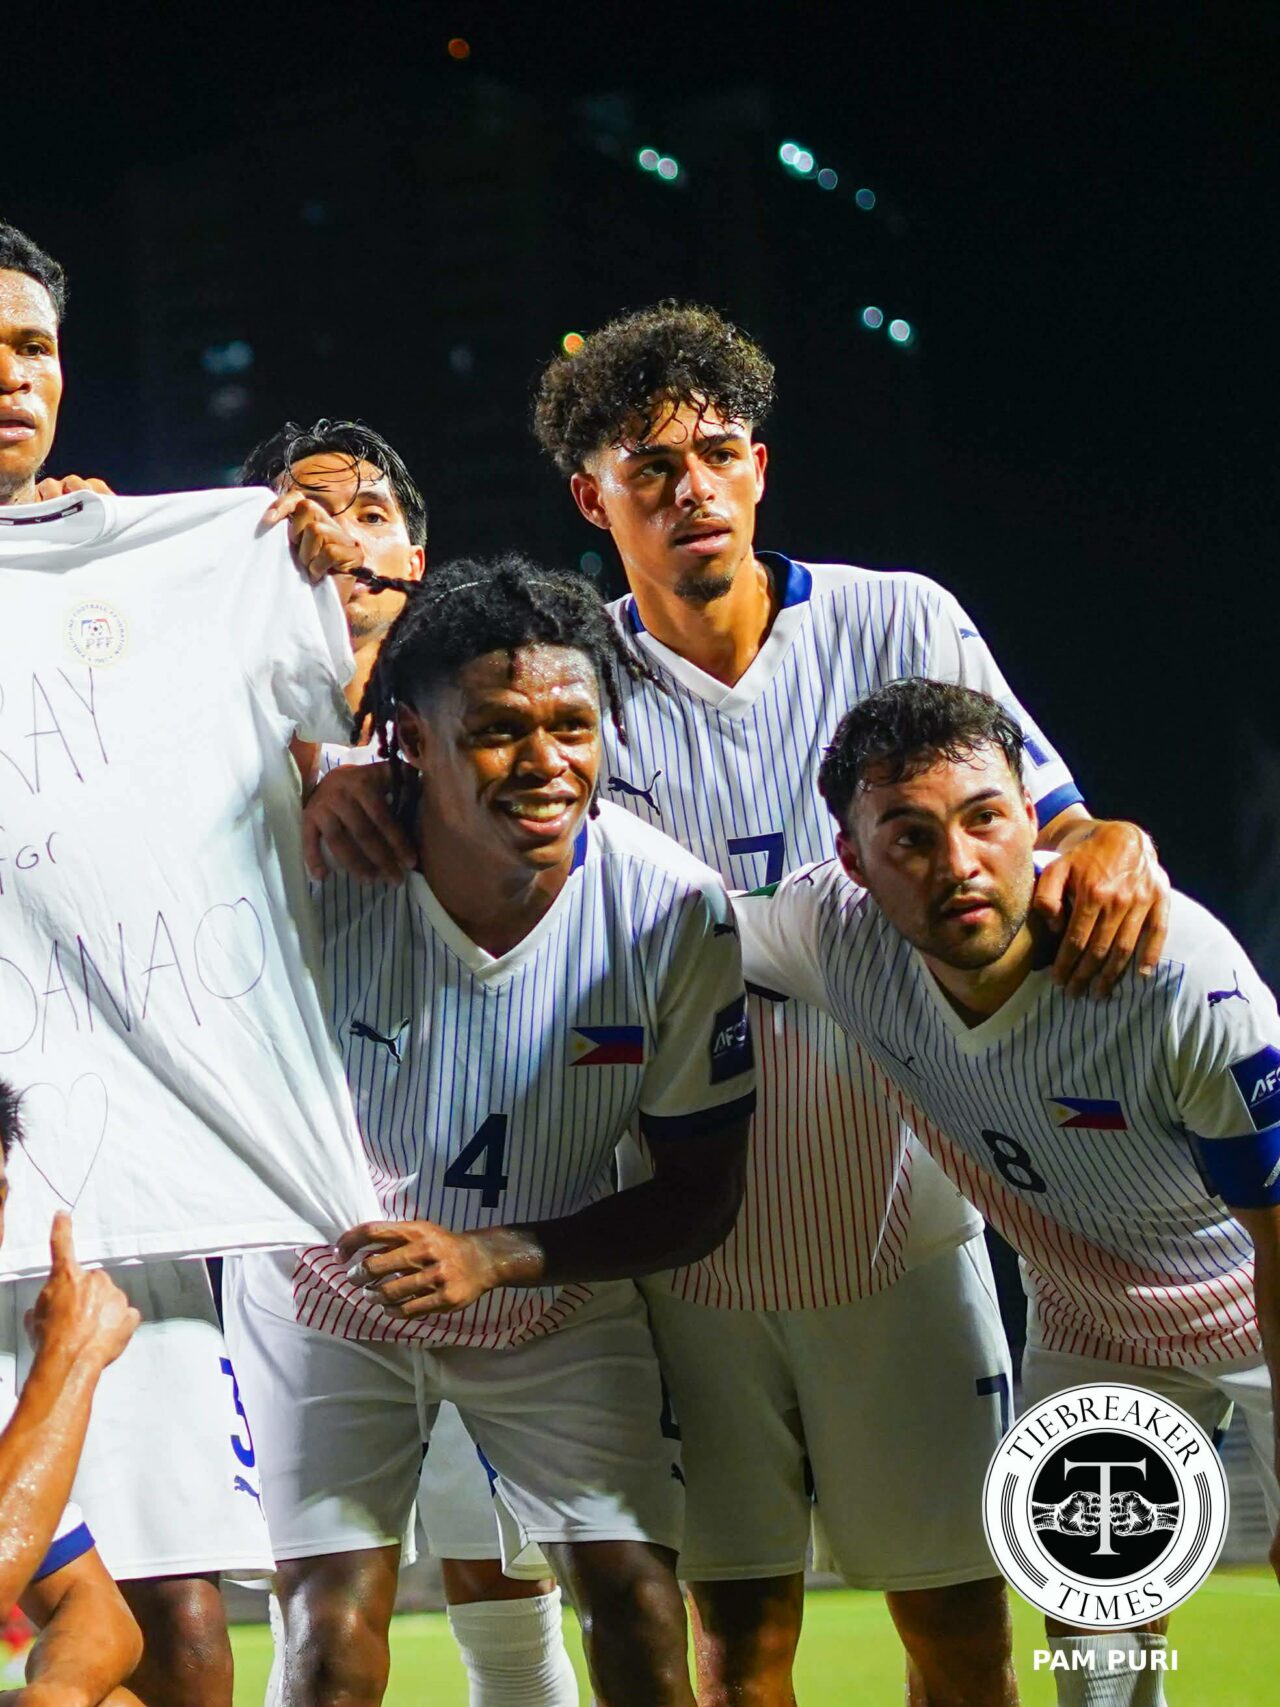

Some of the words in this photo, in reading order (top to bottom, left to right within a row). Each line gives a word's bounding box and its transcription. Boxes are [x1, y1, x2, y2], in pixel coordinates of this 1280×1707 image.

[85, 636, 113, 649] PFF
[727, 832, 785, 886] 7
[444, 1113, 508, 1208] 4
[981, 1129, 1046, 1193] 8
